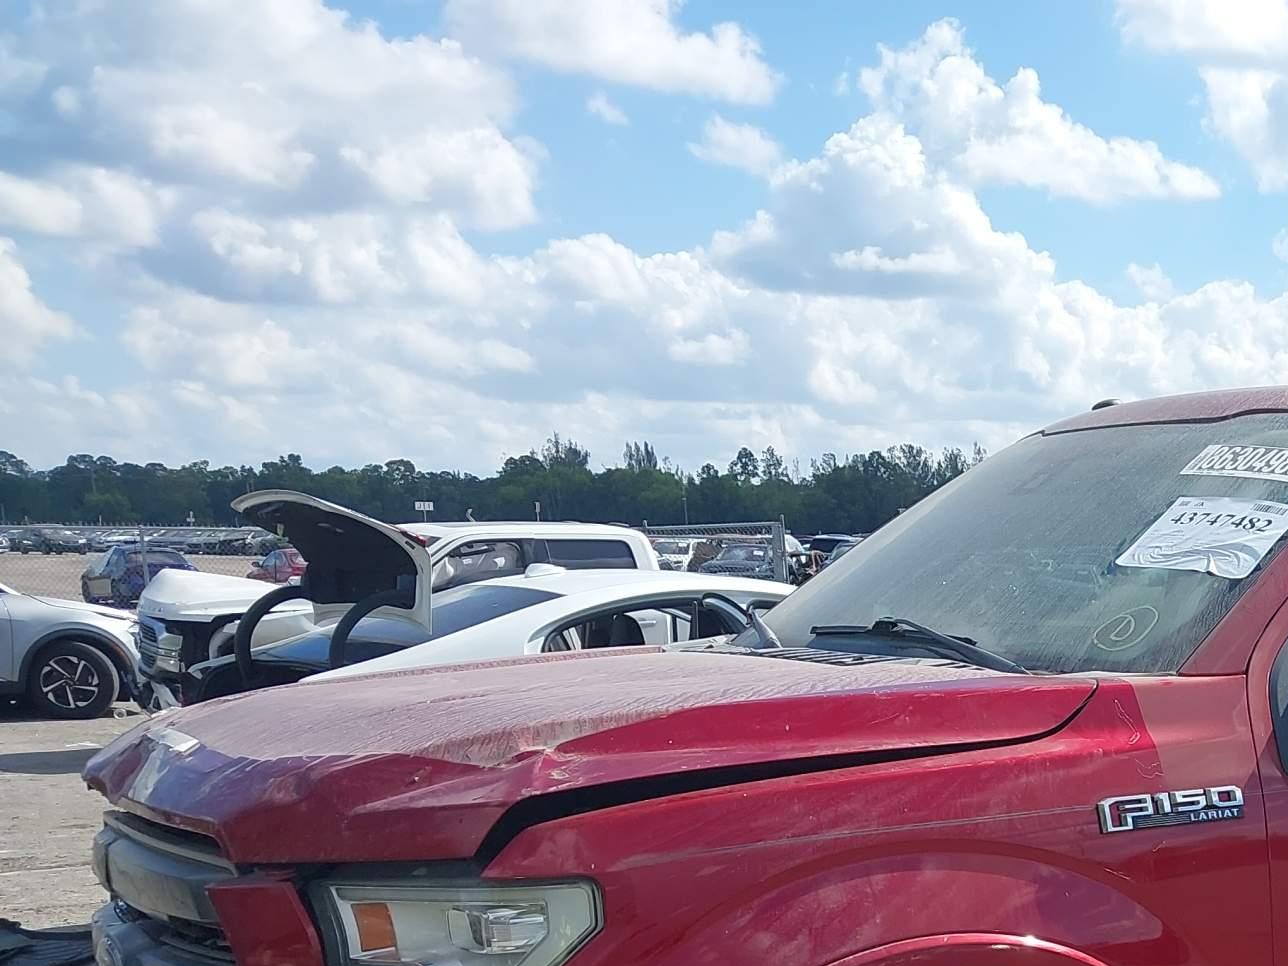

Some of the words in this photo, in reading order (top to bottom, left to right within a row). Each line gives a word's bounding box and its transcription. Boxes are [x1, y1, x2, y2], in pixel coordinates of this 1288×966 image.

[1170, 511, 1273, 533] 43747482
[1097, 785, 1244, 834] F150
[1190, 808, 1240, 822] LARIAT
